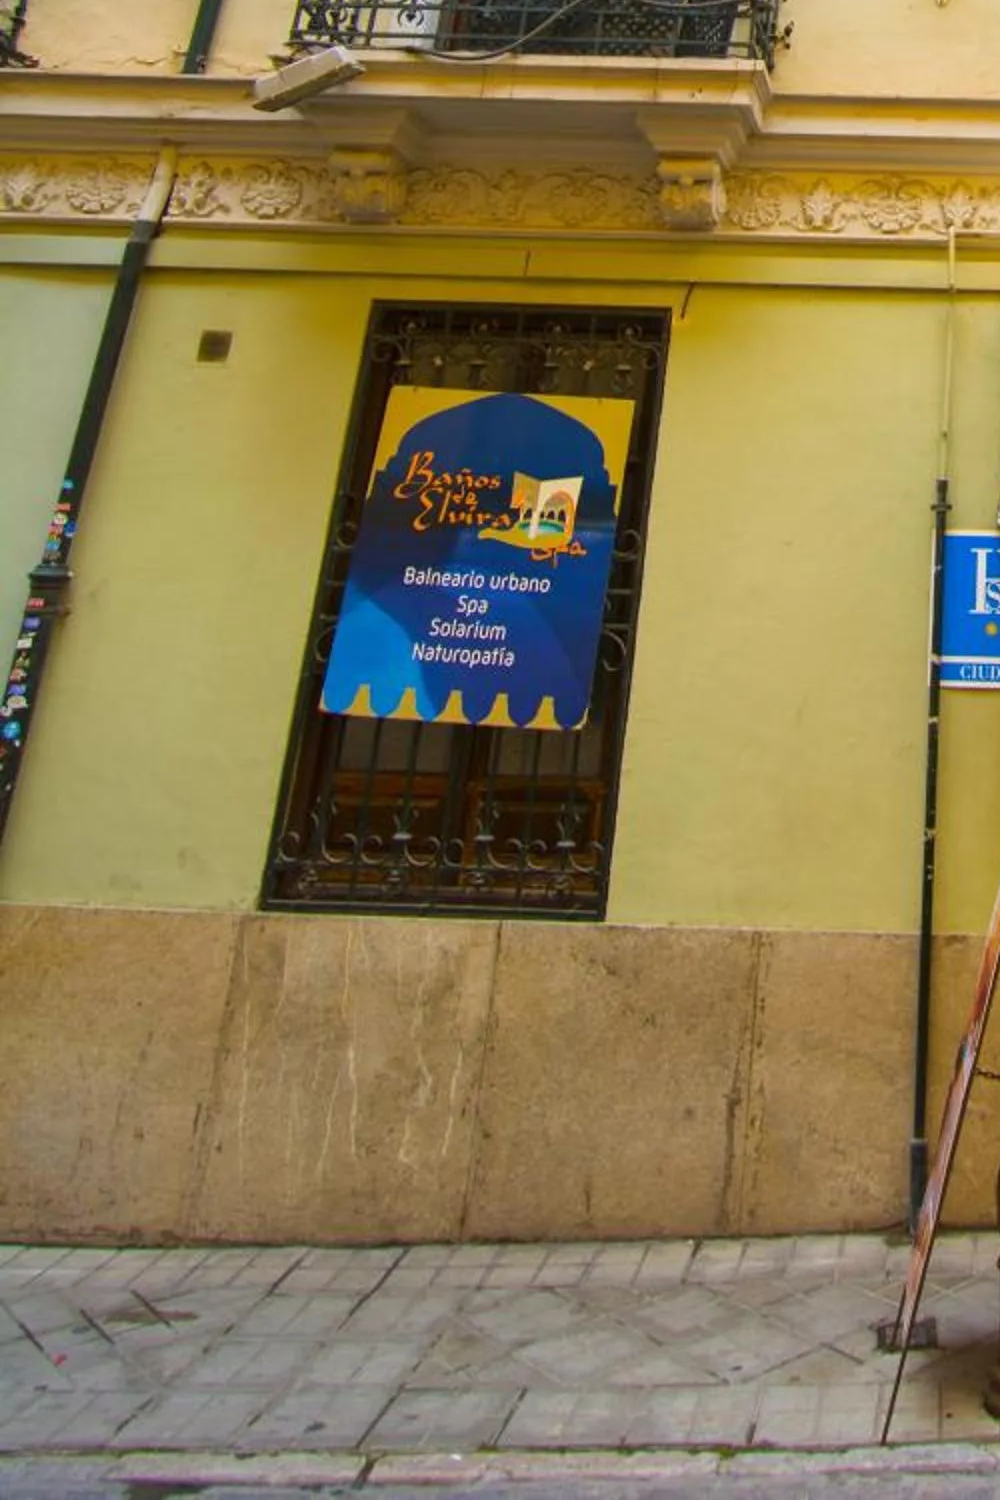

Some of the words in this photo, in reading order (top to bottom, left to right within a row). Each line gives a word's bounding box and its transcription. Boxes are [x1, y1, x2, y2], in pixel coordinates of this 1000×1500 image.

[393, 451, 501, 499] Baños
[413, 486, 513, 531] Elvira
[403, 565, 485, 589] Balneario
[489, 571, 551, 593] urbano
[456, 594, 489, 617] Spa
[428, 616, 507, 641] Solarium
[411, 641, 516, 669] Naturopatía
